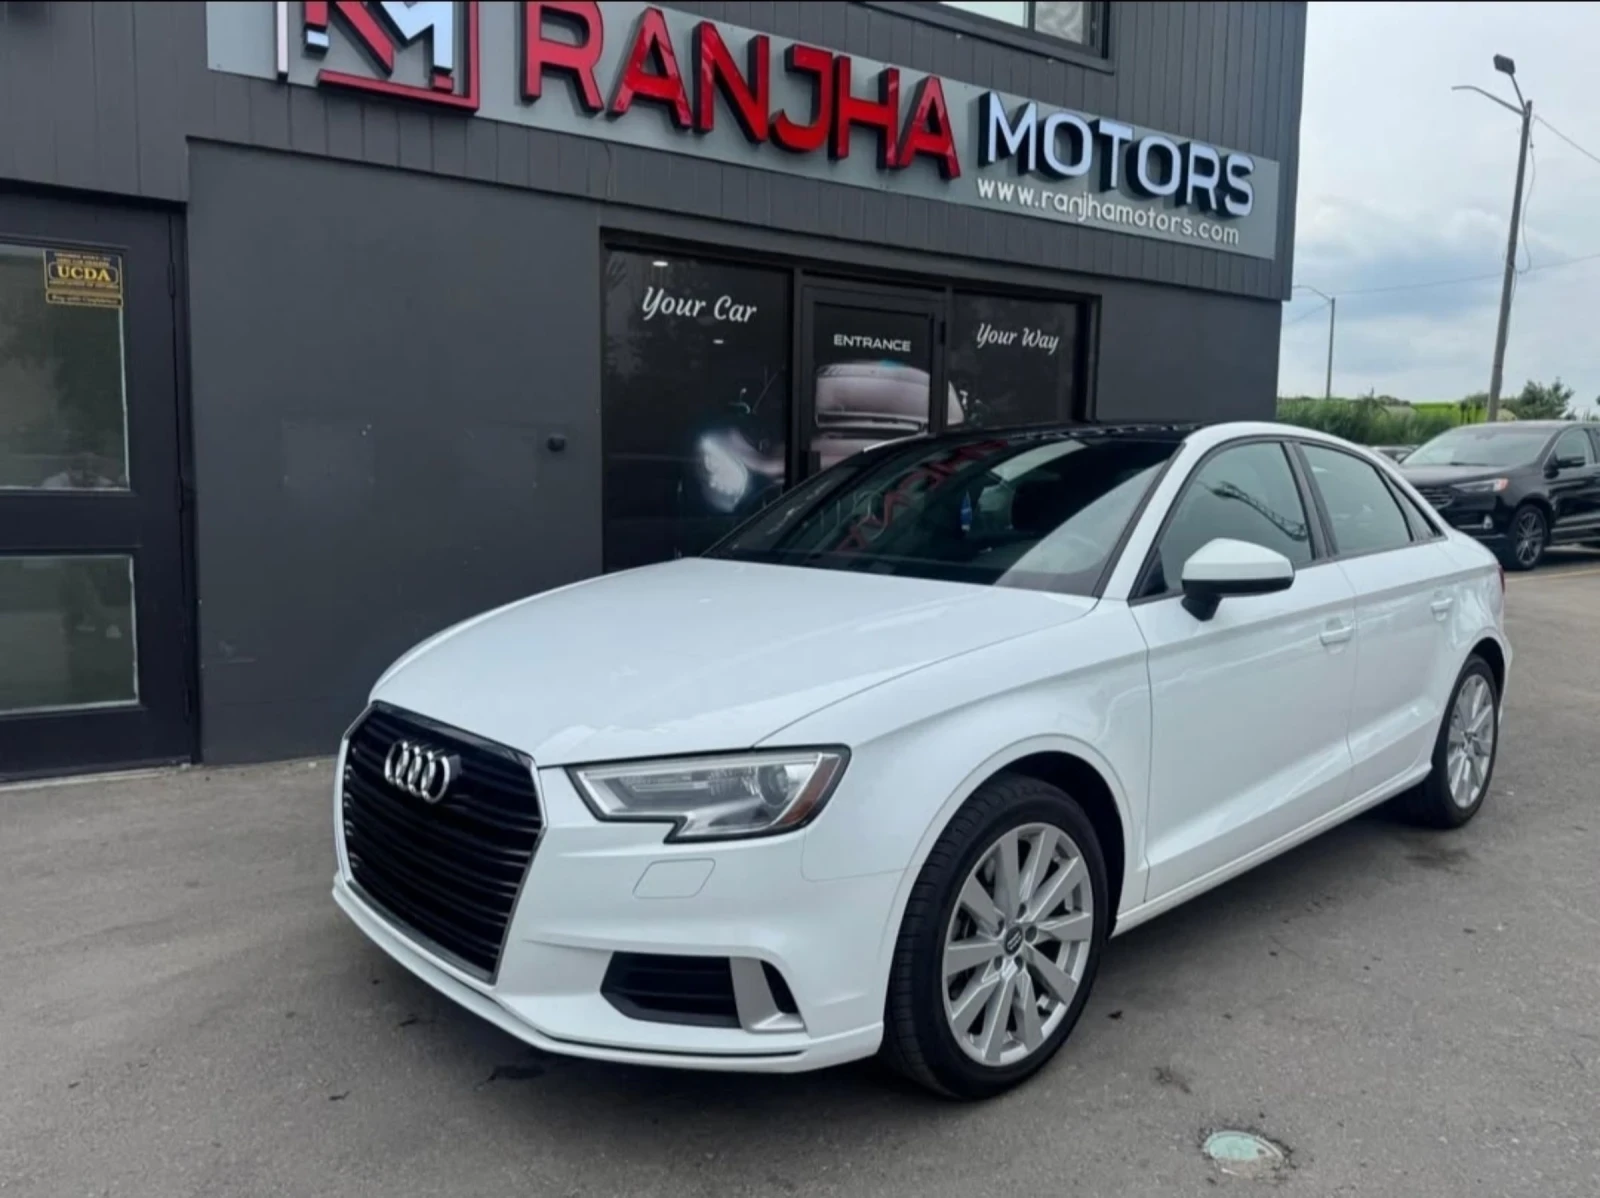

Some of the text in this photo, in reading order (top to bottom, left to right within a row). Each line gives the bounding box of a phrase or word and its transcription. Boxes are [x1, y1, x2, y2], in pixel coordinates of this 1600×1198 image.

[520, 1, 1256, 218] RANJHA MOTORS
[977, 177, 1240, 246] www.ranjhamotors.com
[57, 265, 111, 282] UCDA
[642, 285, 758, 323] Your Car
[832, 333, 912, 352] ENTRANCE
[976, 321, 1060, 356] Your Way
